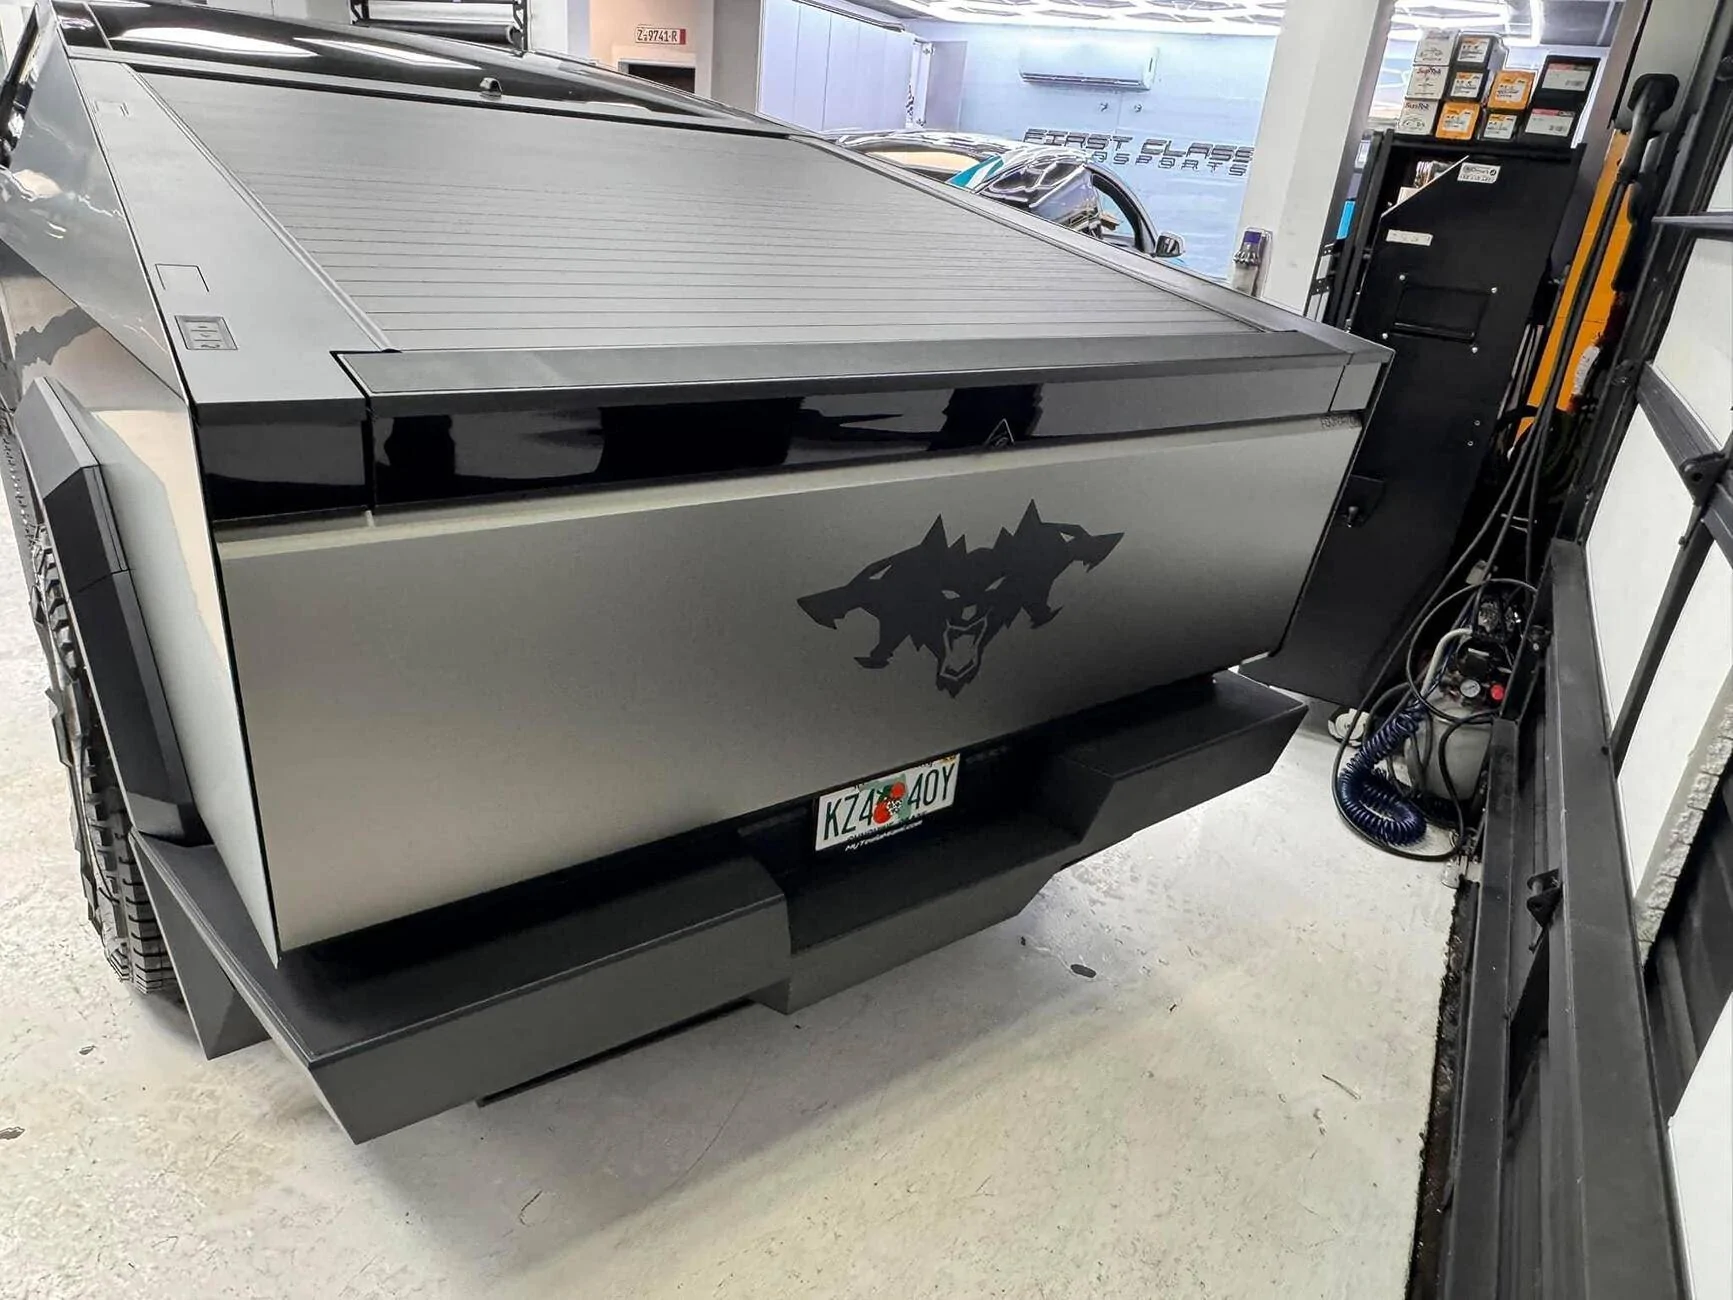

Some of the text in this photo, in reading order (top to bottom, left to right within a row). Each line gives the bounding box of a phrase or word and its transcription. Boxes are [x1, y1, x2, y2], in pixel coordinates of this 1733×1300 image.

[1023, 128, 1255, 163] FIRST CLASS
[823, 788, 876, 841] KZ4
